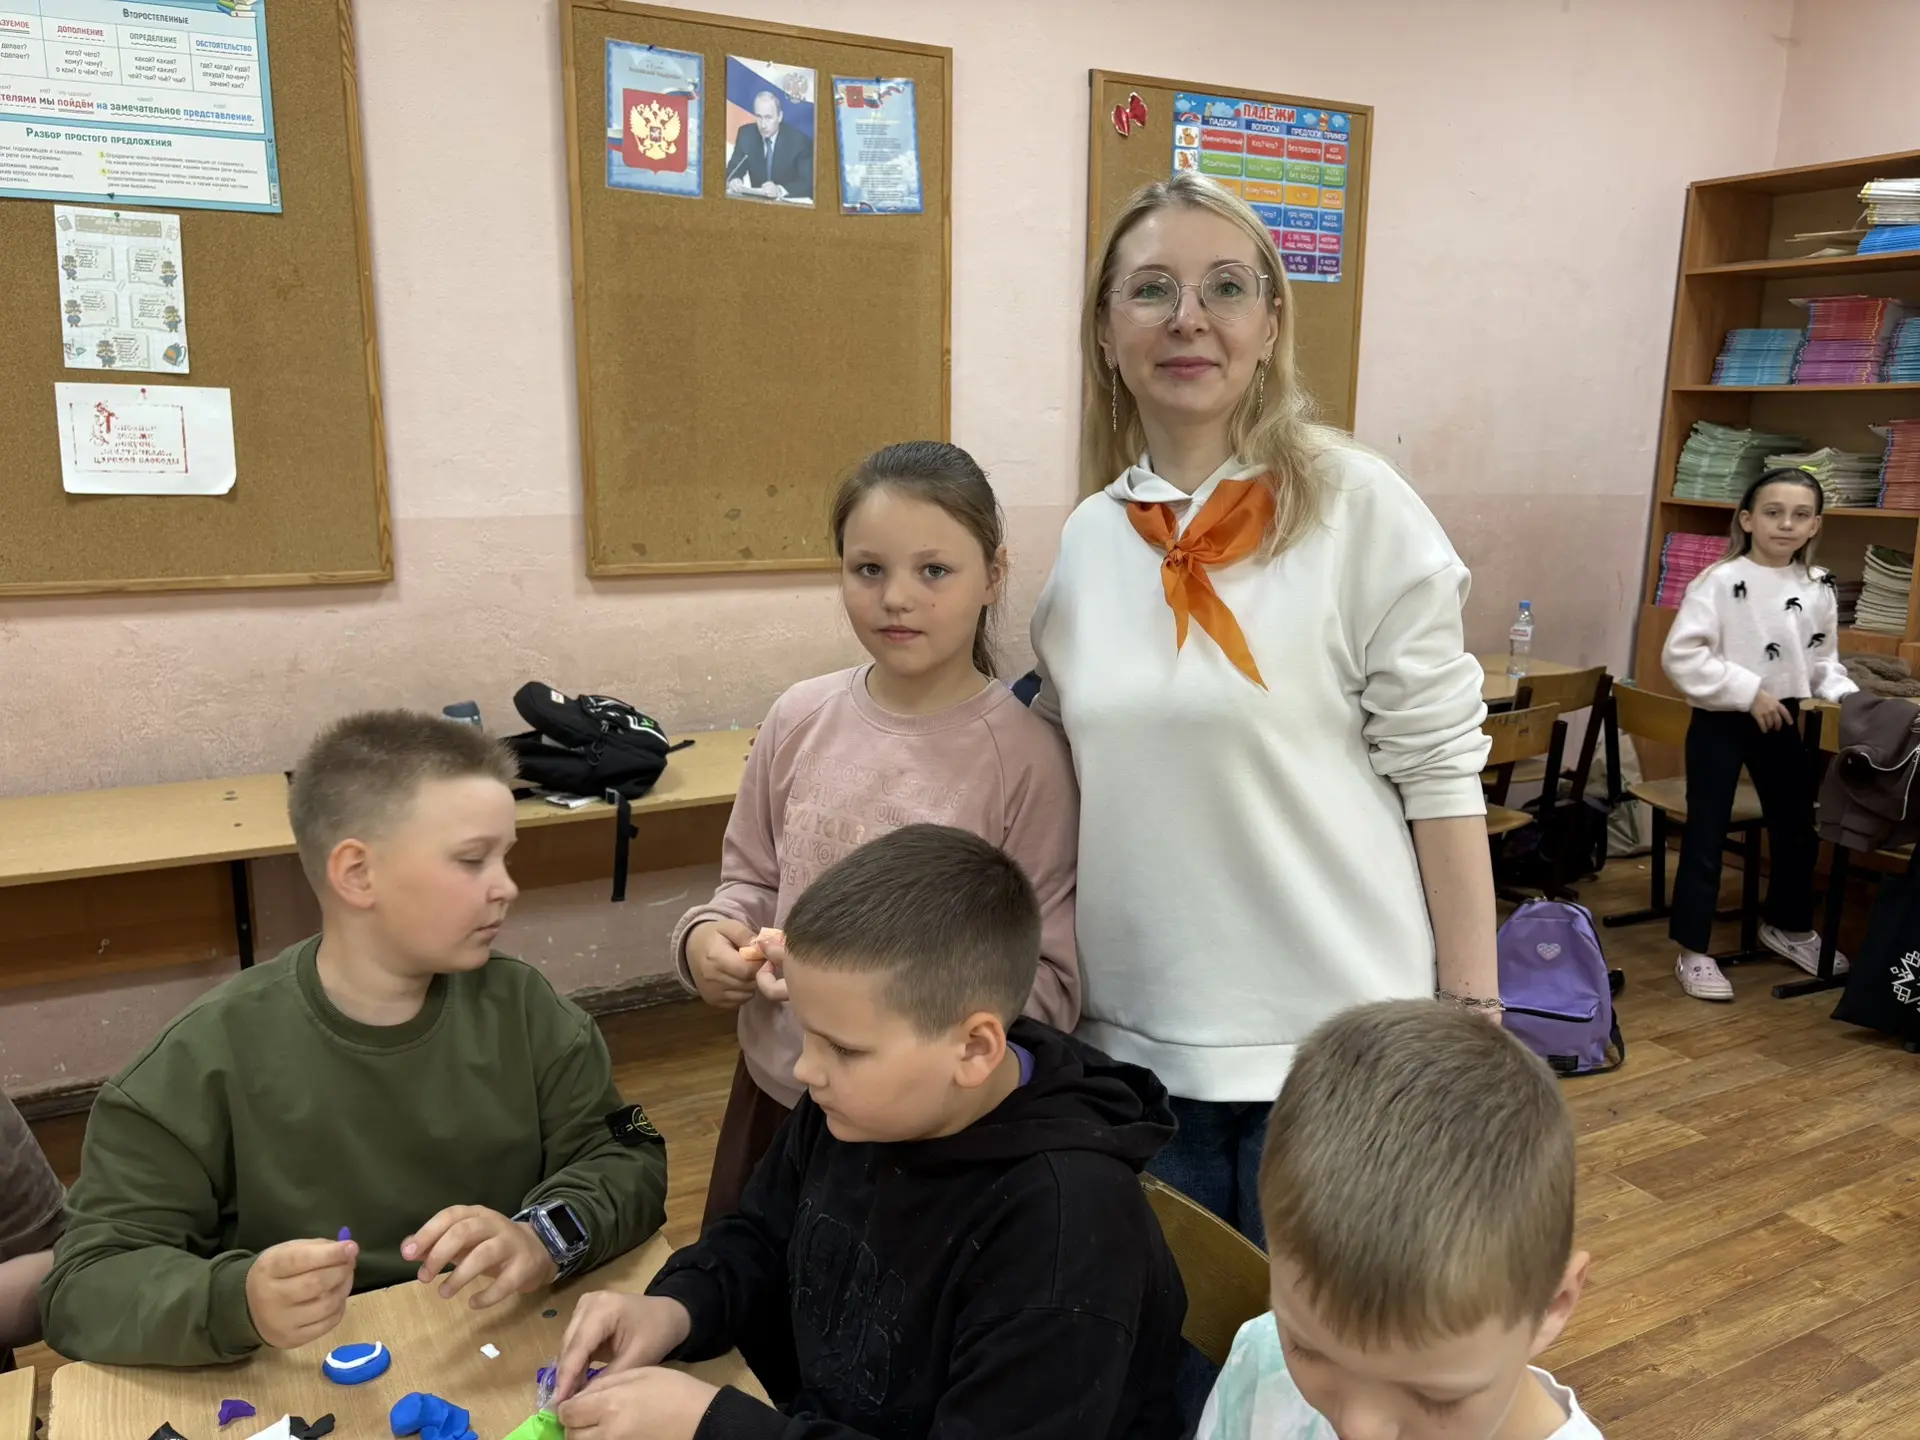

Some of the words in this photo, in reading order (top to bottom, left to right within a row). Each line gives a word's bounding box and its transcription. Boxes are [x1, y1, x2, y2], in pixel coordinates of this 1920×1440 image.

[123, 8, 189, 24] ВТОРОСТЕПЕННЫЕ
[0, 19, 30, 29] ЗУЕМОЕ
[57, 26, 105, 37] ДОПОЛНЕНИЕ
[129, 33, 177, 44] ОПРЕДЕЛЕНИЕ
[195, 40, 252, 52] ОБСТОЯТЕЛЬСТВО
[0, 52, 30, 60] сделает?
[83, 68, 98, 76] чём?
[214, 63, 233, 71] когда?
[202, 71, 225, 79] откуда?
[226, 73, 250, 82] почему?
[0, 93, 37, 104] телями
[39, 97, 55, 106] мы
[57, 97, 94, 109] пойдём
[96, 102, 108, 110] на
[110, 103, 181, 116] замечательное
[183, 108, 254, 122] представление.
[1243, 103, 1296, 123] ПАДЕЖИ
[1209, 118, 1238, 128] ПАДЕЖИ
[1251, 122, 1280, 133] ВОПРОСЫ
[26, 127, 61, 139] РАЗБОР
[65, 133, 107, 143] ПРОСТОГО
[110, 137, 172, 147] ПРЕДЛОЖЕНИЯ
